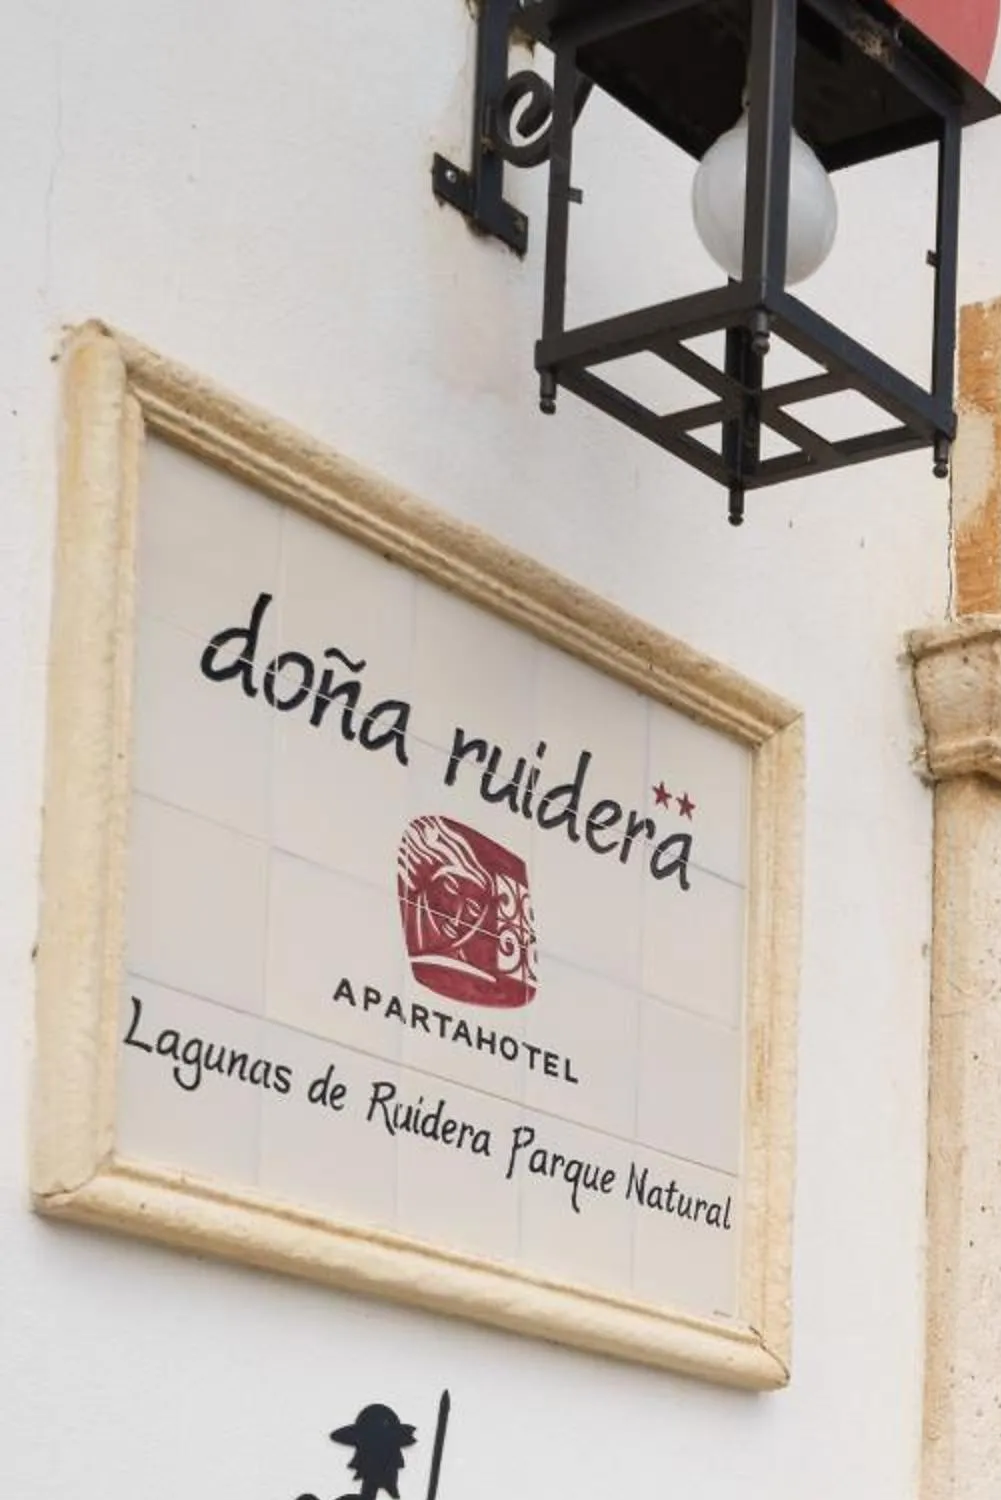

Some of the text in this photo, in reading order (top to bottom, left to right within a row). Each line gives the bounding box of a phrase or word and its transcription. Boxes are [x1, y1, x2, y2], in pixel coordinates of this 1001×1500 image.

[200, 592, 693, 891] doña ruidera
[122, 996, 732, 1231] Lagunas de Ruidera Parque Natural
[333, 978, 579, 1084] APARTAHOTEL
